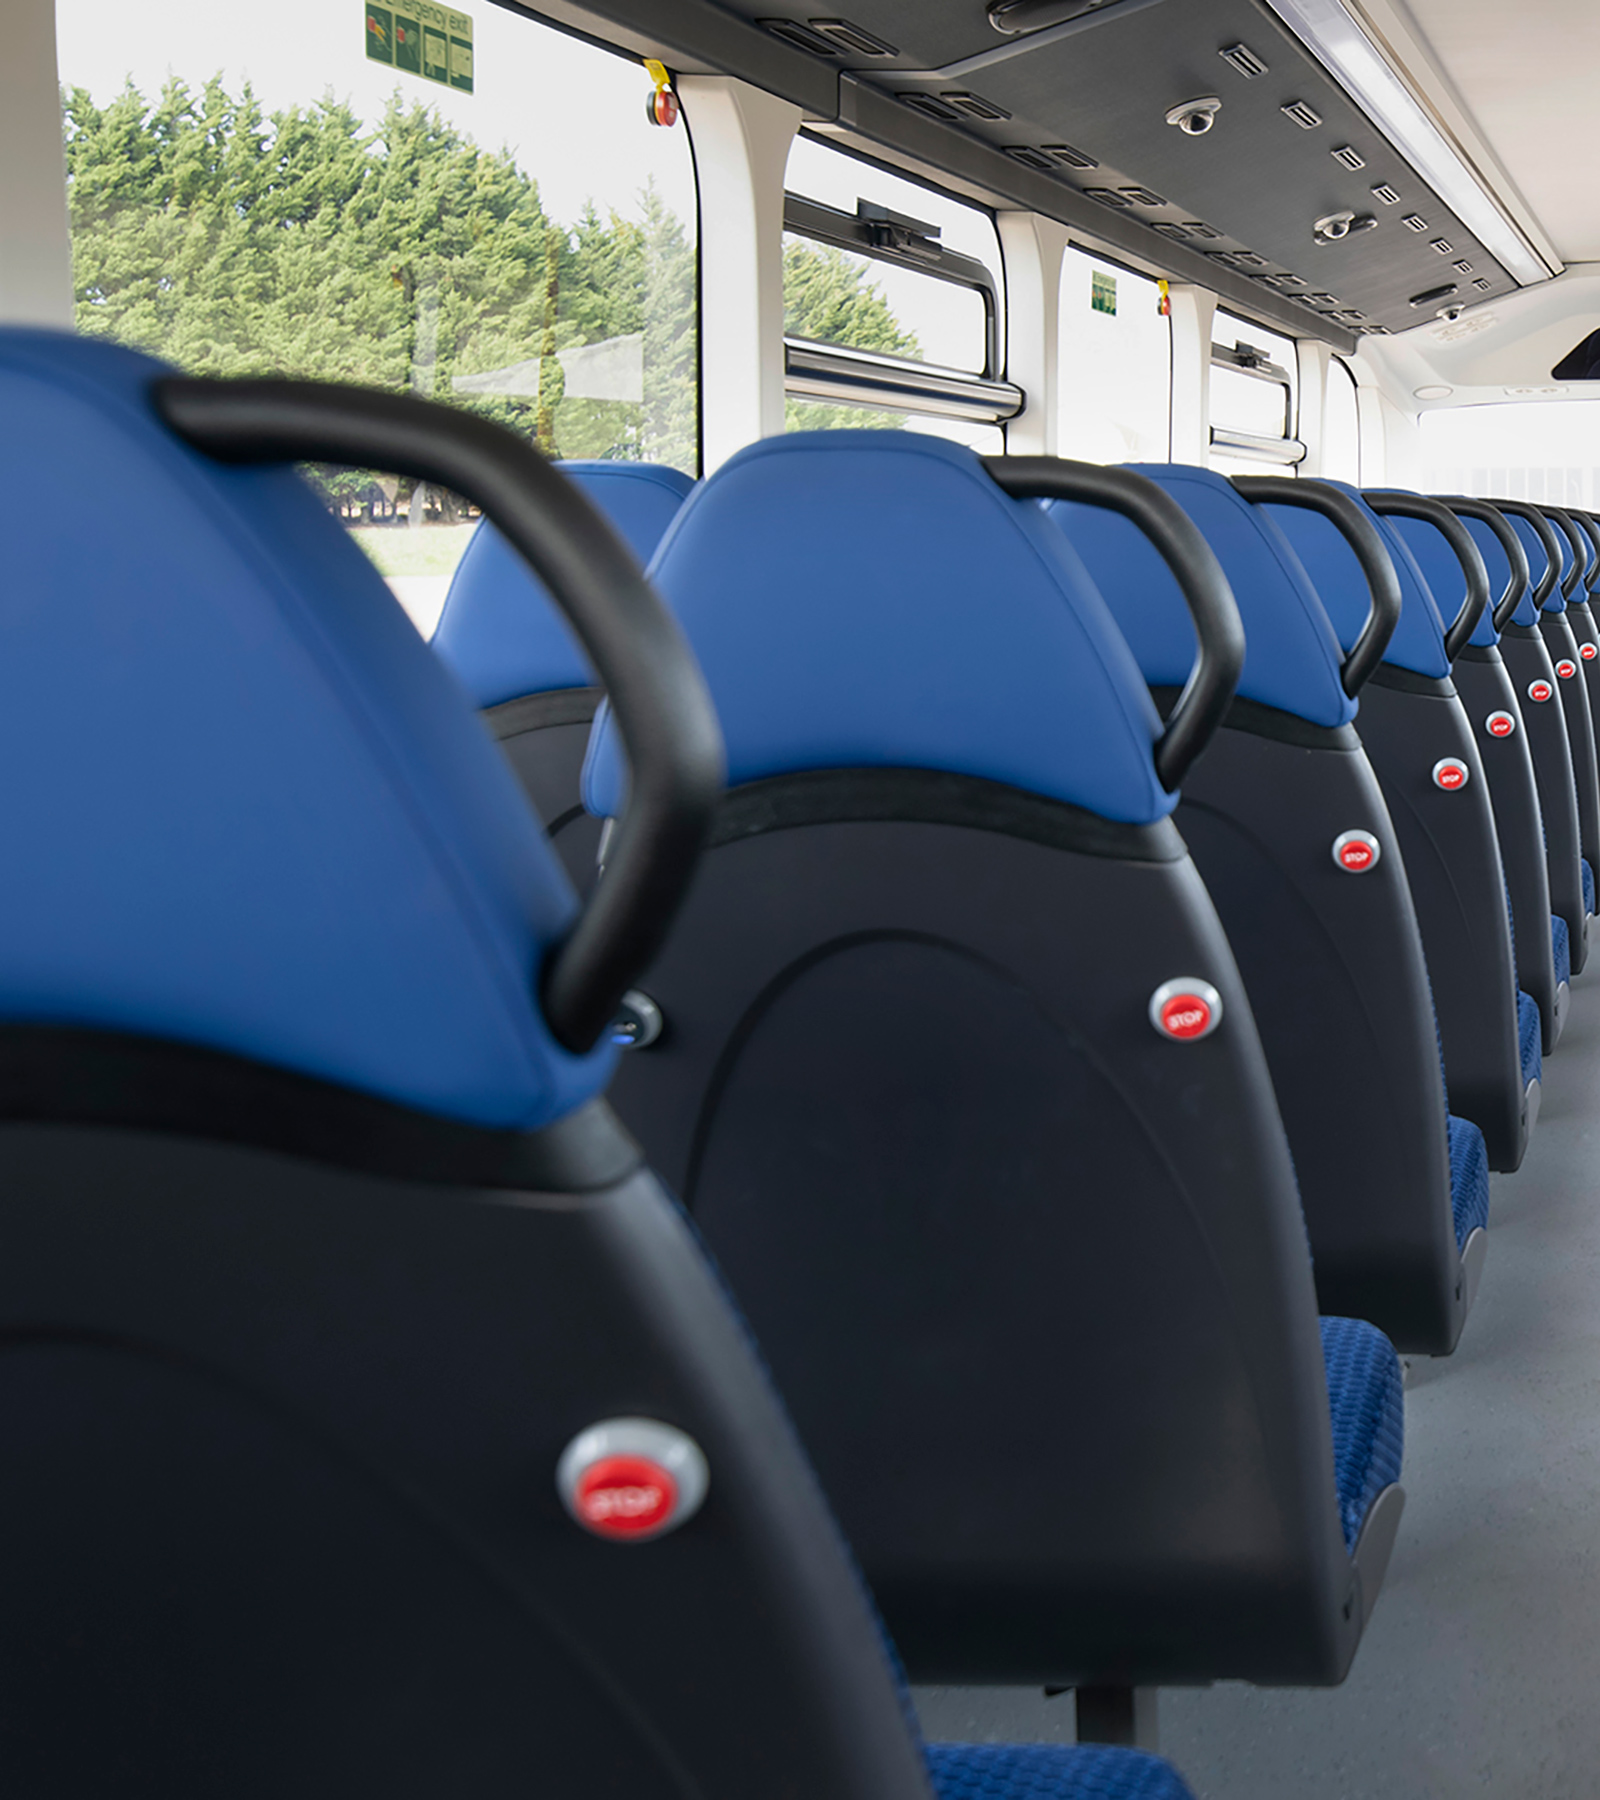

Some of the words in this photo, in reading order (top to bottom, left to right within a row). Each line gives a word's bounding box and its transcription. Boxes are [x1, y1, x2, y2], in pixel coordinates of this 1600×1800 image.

[449, 14, 469, 35] exit
[1441, 774, 1460, 783] STOP
[1344, 852, 1369, 863] STOP
[1167, 1009, 1204, 1030] STOP
[585, 1484, 662, 1521] STOP
